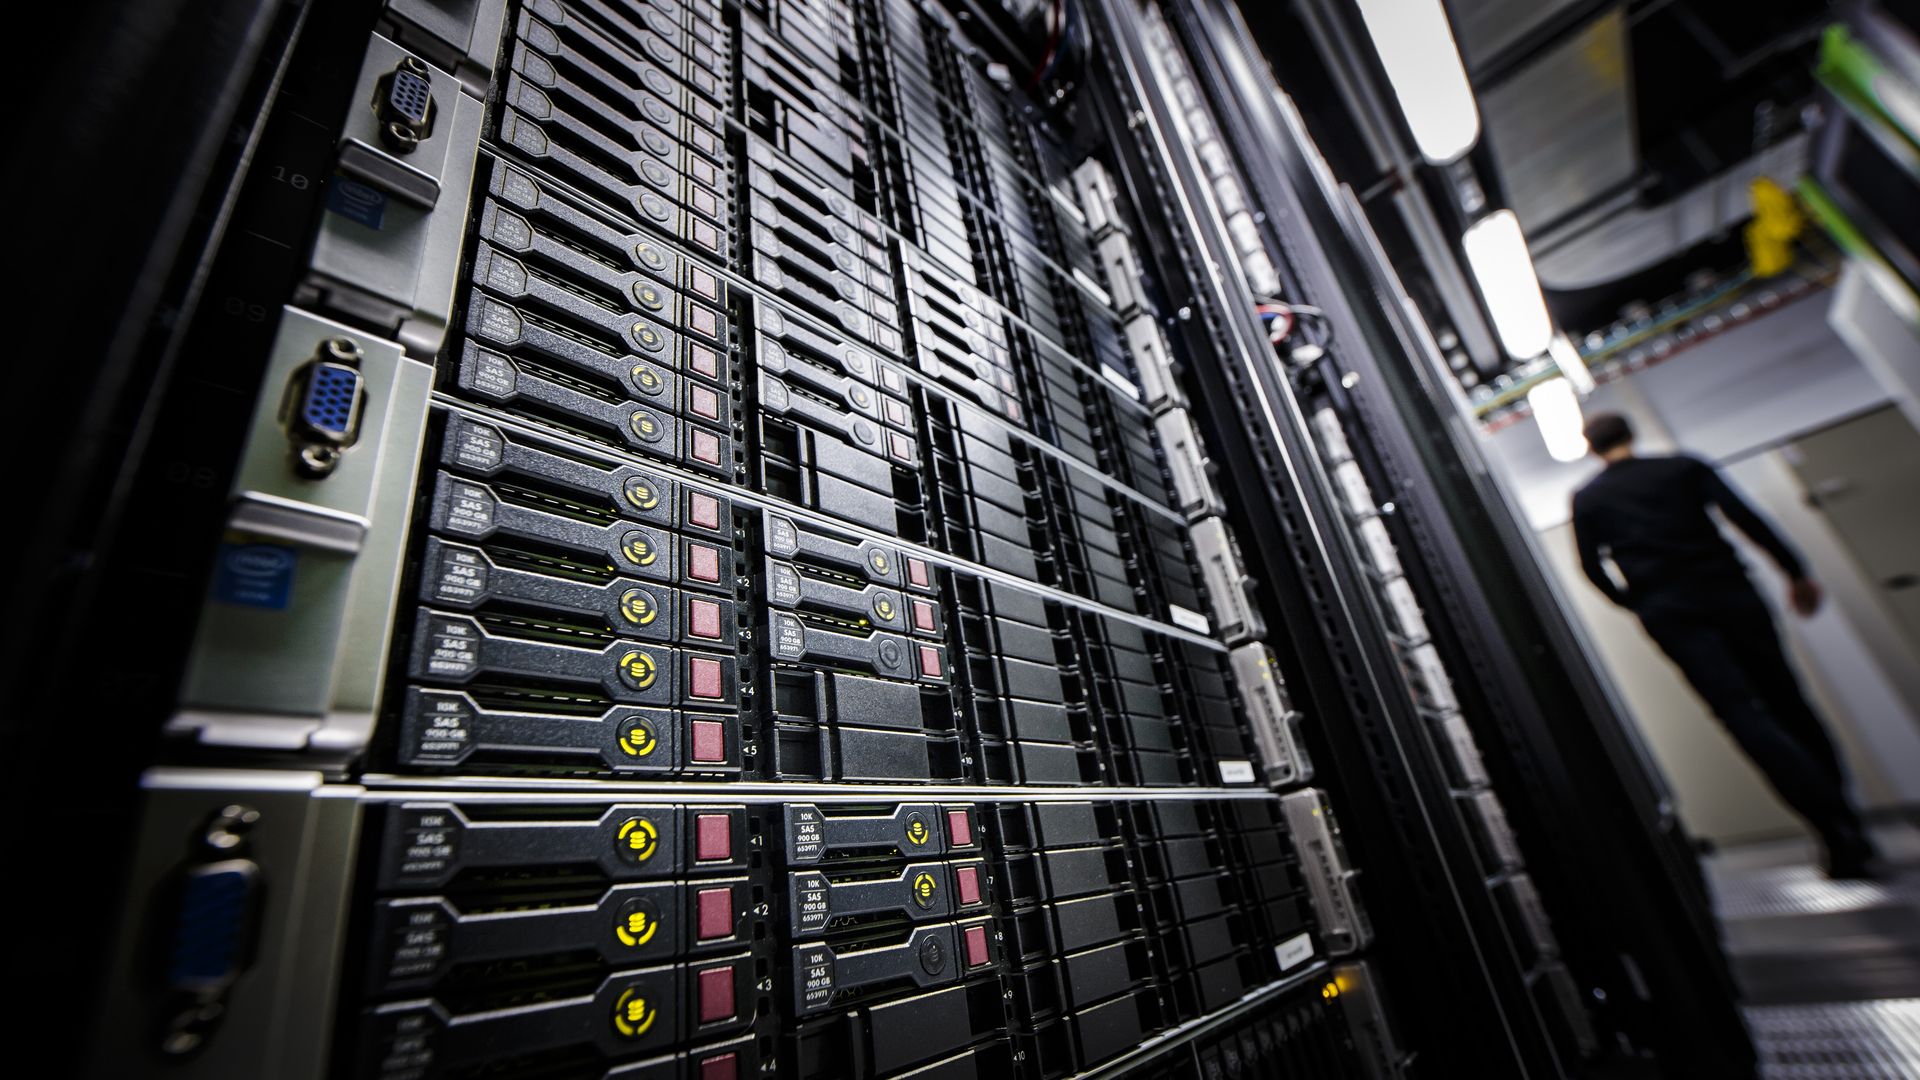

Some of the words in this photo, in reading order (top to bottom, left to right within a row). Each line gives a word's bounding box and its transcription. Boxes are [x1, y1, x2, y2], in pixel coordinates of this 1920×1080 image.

[271, 165, 309, 191] 10
[501, 259, 515, 268] 10K
[498, 266, 515, 278] SAS
[224, 296, 267, 323] 09
[494, 305, 510, 316] 10K
[485, 319, 501, 329] 900
[491, 314, 509, 325] SAS
[488, 356, 504, 367] 10K
[485, 365, 504, 377] SAS
[479, 371, 496, 381] 900
[496, 378, 509, 386] GB
[473, 426, 490, 437] 10K
[470, 436, 490, 448] SAS
[463, 443, 482, 453] 900
[482, 449, 496, 457] GB
[740, 466, 746, 474] 5
[464, 488, 482, 498] 10K
[460, 499, 482, 511] SAS
[453, 506, 474, 517] 900
[777, 529, 790, 538] SAS
[456, 553, 476, 564] 10K
[452, 565, 476, 577] SAS
[780, 567, 791, 576] 10K
[444, 574, 465, 584] 900
[743, 578, 750, 588] 2
[780, 577, 793, 586] SAS
[783, 619, 795, 627] 10K
[446, 624, 467, 636] 10K
[745, 630, 752, 640] 3
[783, 629, 797, 637] SAS
[442, 638, 467, 650] SAS
[748, 686, 755, 696] 4
[437, 702, 460, 712] 10K
[957, 710, 963, 718] 9
[433, 716, 460, 728] SAS
[751, 745, 758, 755] 5
[965, 756, 973, 765] 10
[800, 812, 813, 821] 10K
[800, 824, 815, 834] SAS
[980, 824, 986, 833] 6
[758, 835, 763, 847] 1
[797, 834, 810, 842] 900
[810, 833, 820, 841] GB
[797, 844, 818, 852] 653971
[807, 880, 820, 888] 10K
[988, 875, 994, 885] 7
[807, 892, 822, 902] SAS
[762, 903, 769, 916] 2
[803, 902, 816, 911] 900
[816, 902, 827, 910] GB
[802, 913, 824, 922] 653971
[998, 931, 1004, 941] 8
[810, 953, 824, 964] 10K
[810, 966, 826, 979] SAS
[765, 978, 772, 991] 3
[807, 978, 821, 989] 900
[820, 976, 831, 986] GB
[806, 989, 828, 1001] 653971
[1007, 990, 1013, 999] 9
[1016, 1050, 1025, 1062] 10
[769, 1058, 777, 1072] 4
